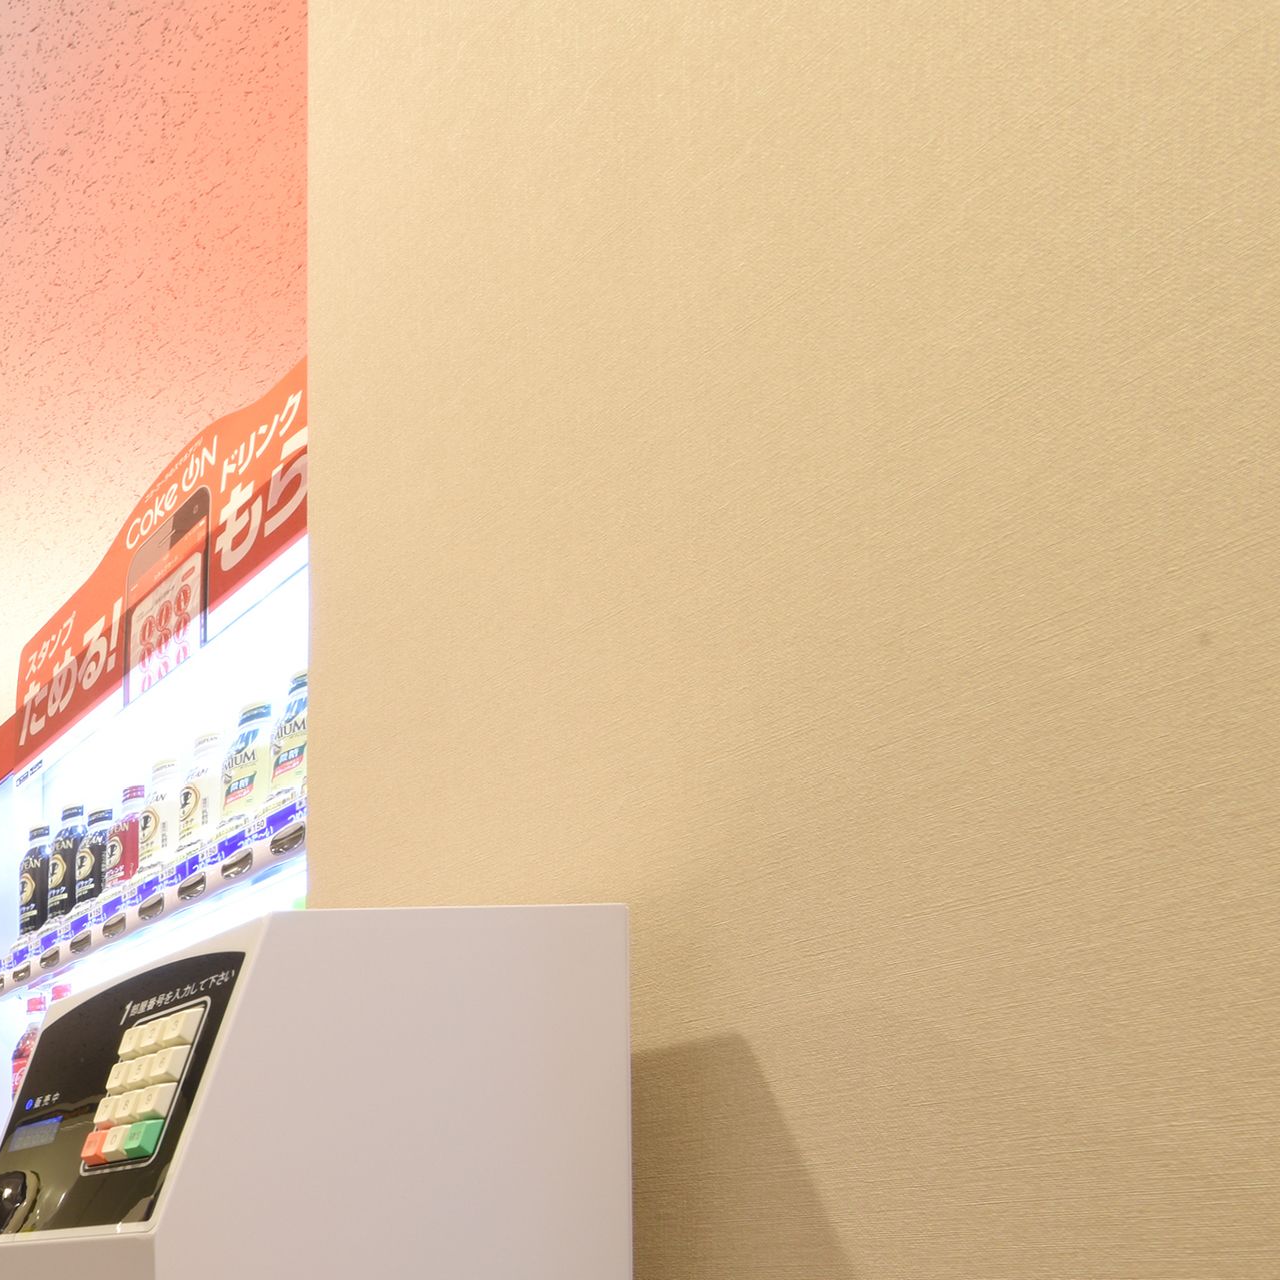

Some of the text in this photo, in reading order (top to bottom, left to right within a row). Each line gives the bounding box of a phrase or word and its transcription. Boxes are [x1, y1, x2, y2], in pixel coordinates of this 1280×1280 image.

[220, 390, 303, 493] ドリンク
[126, 483, 178, 550] Coke
[181, 434, 218, 492] ON
[25, 611, 77, 681] スタンプ
[129, 969, 236, 1018] 部屋番号を入力して下さい
